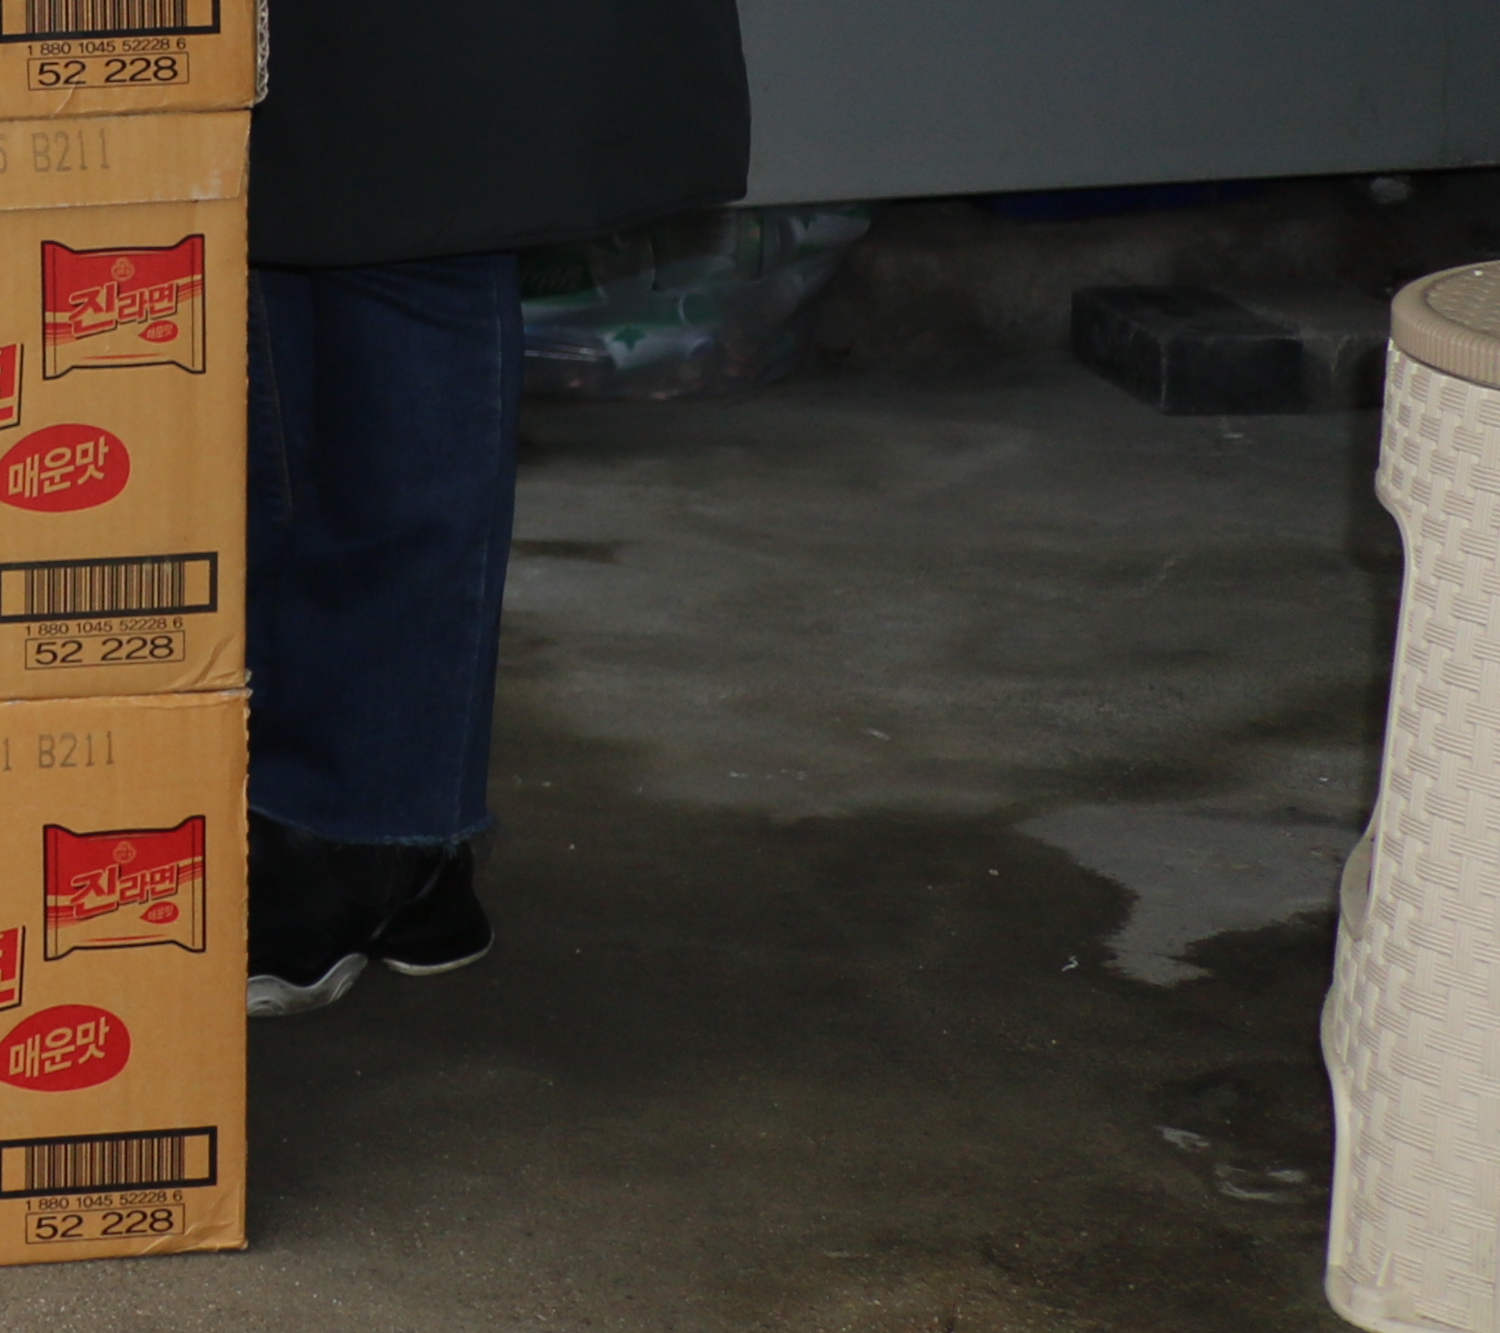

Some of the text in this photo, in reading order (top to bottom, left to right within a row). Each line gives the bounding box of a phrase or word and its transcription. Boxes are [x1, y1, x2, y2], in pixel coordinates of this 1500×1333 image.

[40, 42, 72, 56] 880
[79, 40, 116, 54] 1045
[122, 37, 171, 52] 52228
[37, 55, 179, 87] 52 228
[34, 129, 110, 172] B211
[67, 277, 179, 341] 진라면
[5, 438, 108, 497] 매운맛
[38, 622, 70, 637] 880
[76, 620, 113, 635] 1045
[119, 617, 168, 632] 52228
[35, 634, 176, 668] 52 228
[38, 731, 115, 769] B211
[68, 860, 182, 923] 진라면
[6, 1017, 109, 1075] 매운맛
[38, 1196, 70, 1210] 880
[76, 1193, 113, 1208] 1045
[119, 1190, 168, 1205] 52228
[34, 1207, 175, 1240] 52 228
